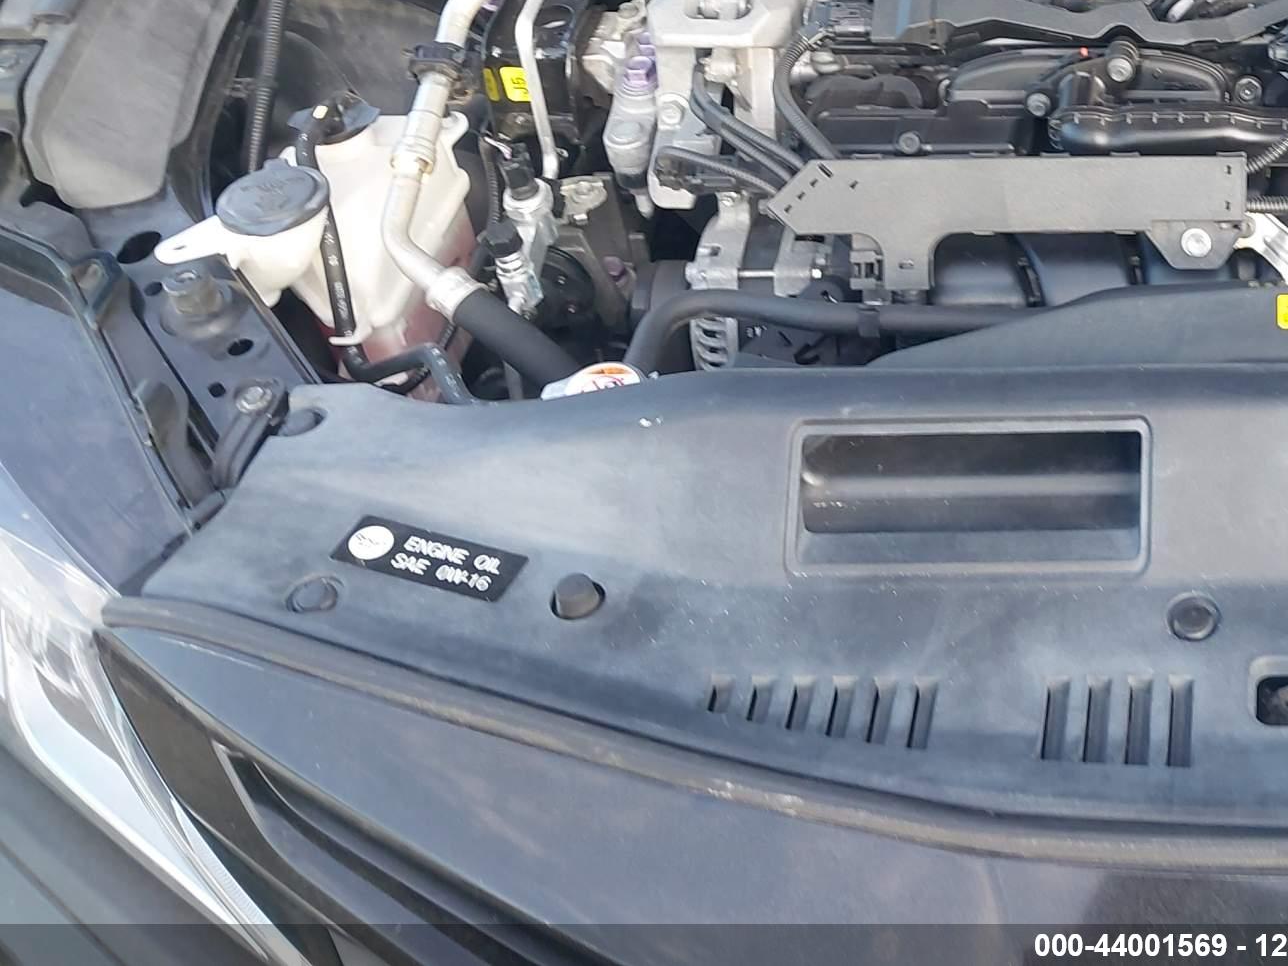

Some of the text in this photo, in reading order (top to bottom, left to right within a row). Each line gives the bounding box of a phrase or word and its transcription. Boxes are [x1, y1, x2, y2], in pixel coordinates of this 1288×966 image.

[390, 552, 493, 593] SAE 0W-16
[403, 535, 470, 566] ENGINE
[473, 554, 502, 576] OIL
